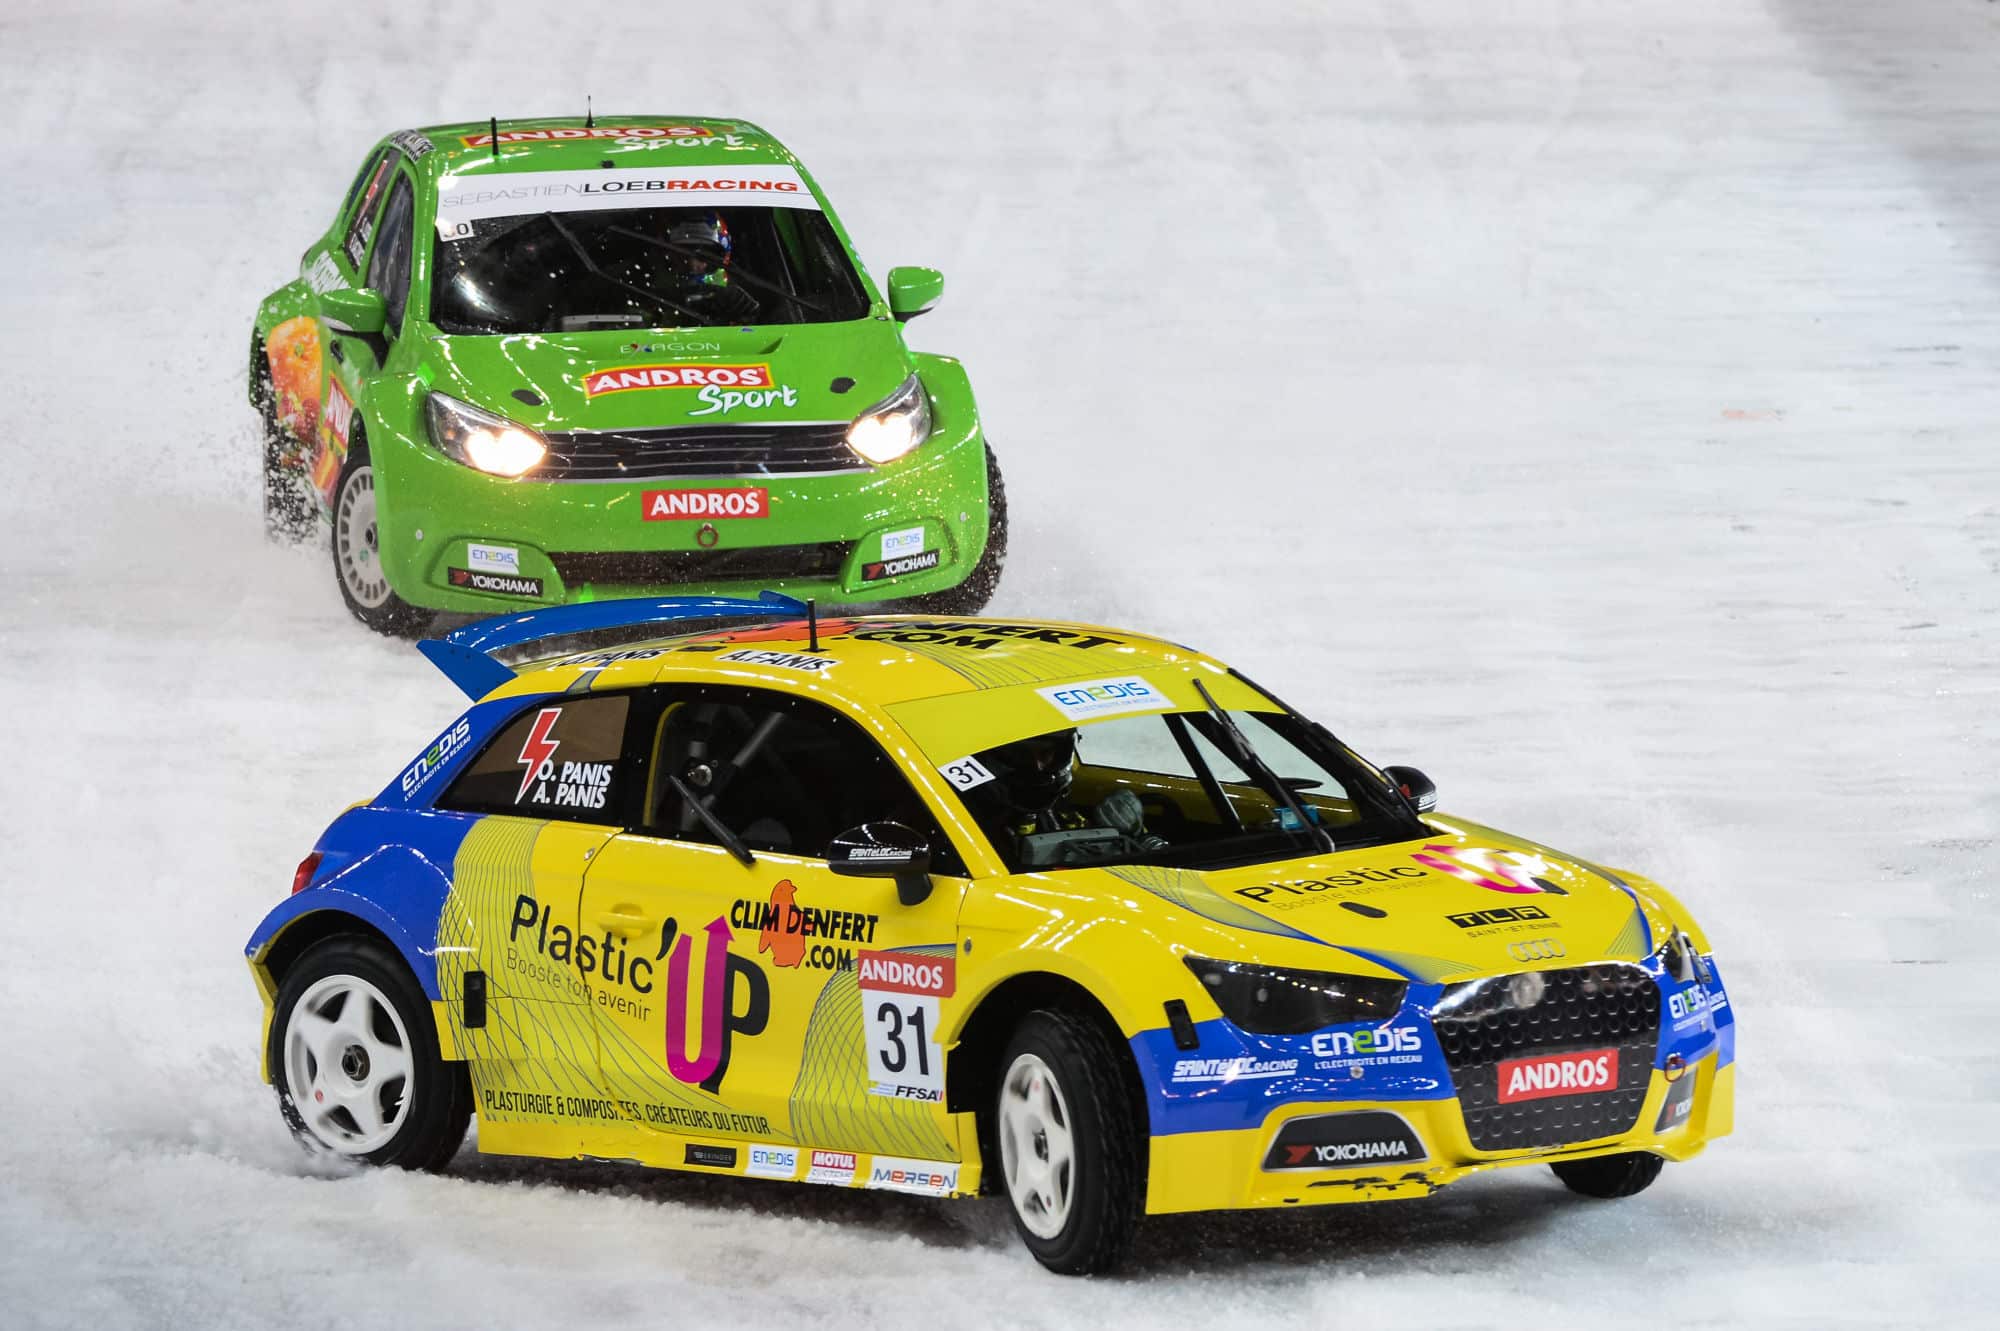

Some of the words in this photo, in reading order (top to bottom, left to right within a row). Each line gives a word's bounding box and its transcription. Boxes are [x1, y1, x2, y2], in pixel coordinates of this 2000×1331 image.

[474, 127, 702, 145] ANDROS
[604, 135, 746, 154] Sport
[592, 367, 763, 392] ANDROS
[688, 384, 798, 416] Sport
[650, 492, 760, 516] ANDROS
[884, 552, 938, 576] YOKOHAMA
[471, 574, 539, 594] YOKOHAMA
[537, 760, 557, 783] O.
[560, 761, 613, 788] PANIS
[949, 759, 985, 785] 31
[532, 782, 550, 805] A.
[554, 783, 608, 809] PANIS
[1233, 866, 1428, 903] Plastic
[730, 899, 779, 932] CLIM
[786, 903, 879, 944] DENFERT
[805, 945, 851, 972] .COM
[506, 947, 562, 988] Booste
[567, 975, 593, 1000] ton
[598, 990, 652, 1021] avenir
[858, 958, 944, 990] ANDROS
[876, 1001, 930, 1077] 31
[1507, 1056, 1609, 1096] ANDROS
[895, 1084, 938, 1102] FFSA
[485, 1090, 553, 1114] PLASTURGIE
[556, 1091, 565, 1115] &
[712, 1111, 731, 1131] DU
[733, 1112, 772, 1135] FUTUR
[813, 1151, 855, 1168] MOTUL
[1314, 1140, 1409, 1162] YOKOHAMA
